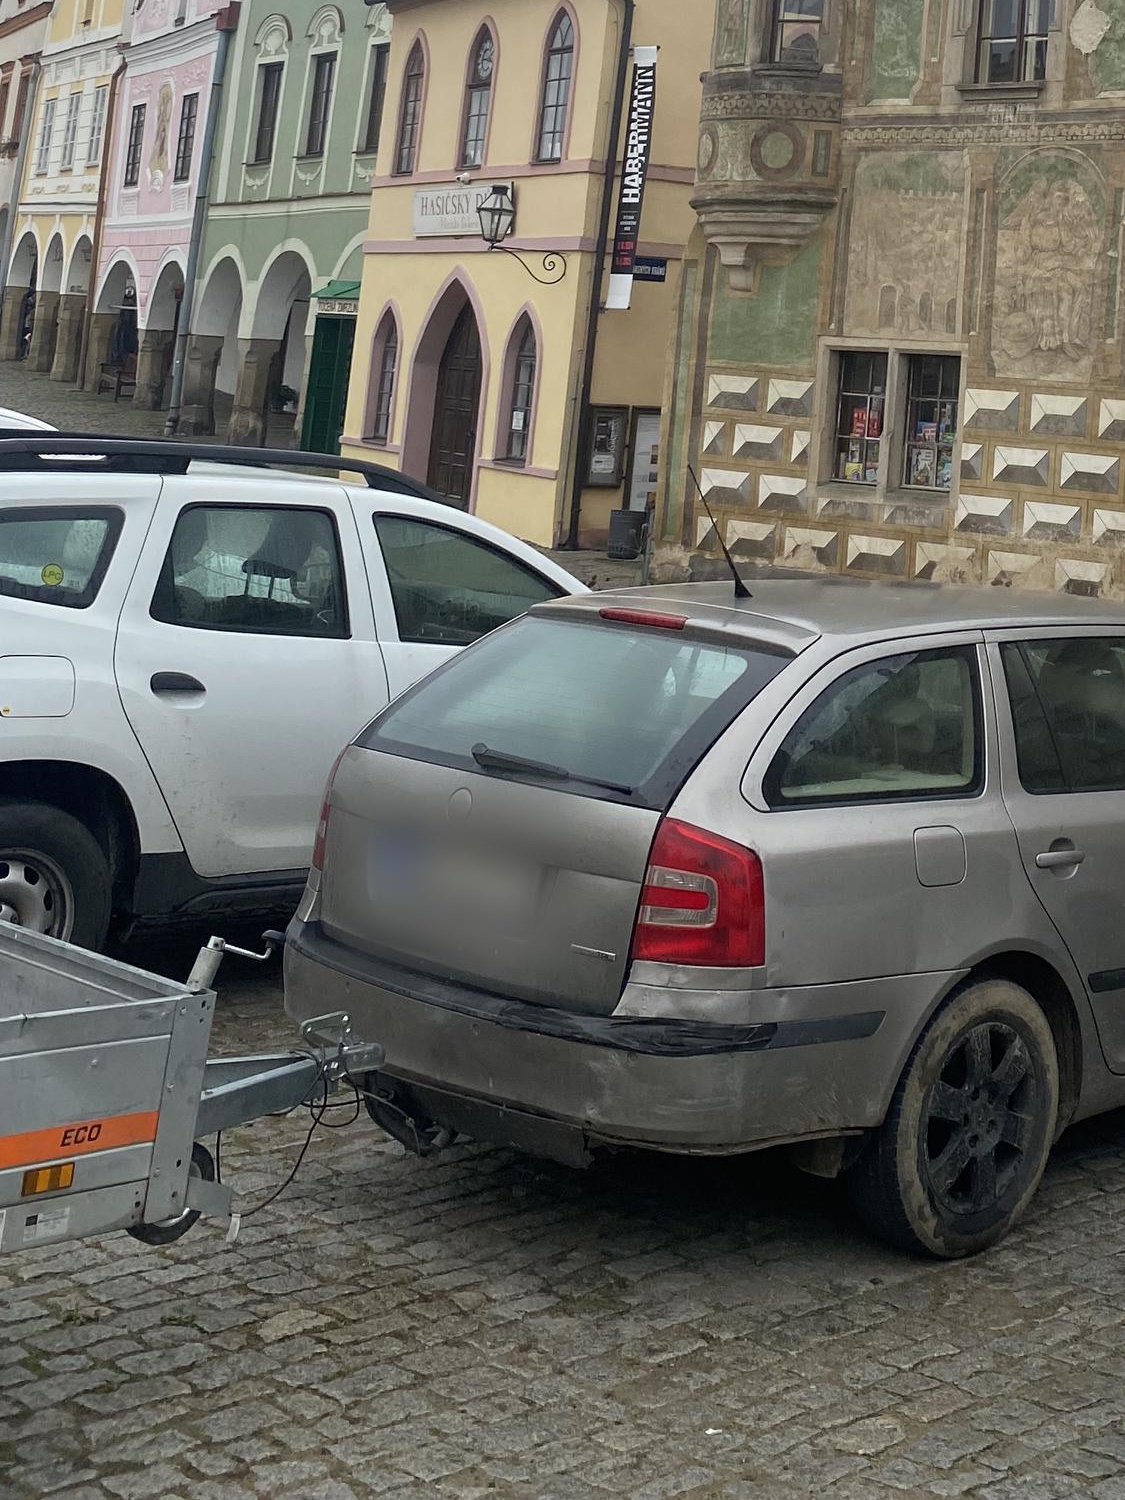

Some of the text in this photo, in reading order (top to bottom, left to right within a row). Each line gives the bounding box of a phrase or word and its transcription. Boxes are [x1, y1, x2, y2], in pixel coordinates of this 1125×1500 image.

[622, 65, 654, 203] HABERMANN
[421, 191, 471, 216] HASIČSKÝ
[60, 1123, 102, 1147] ECO
